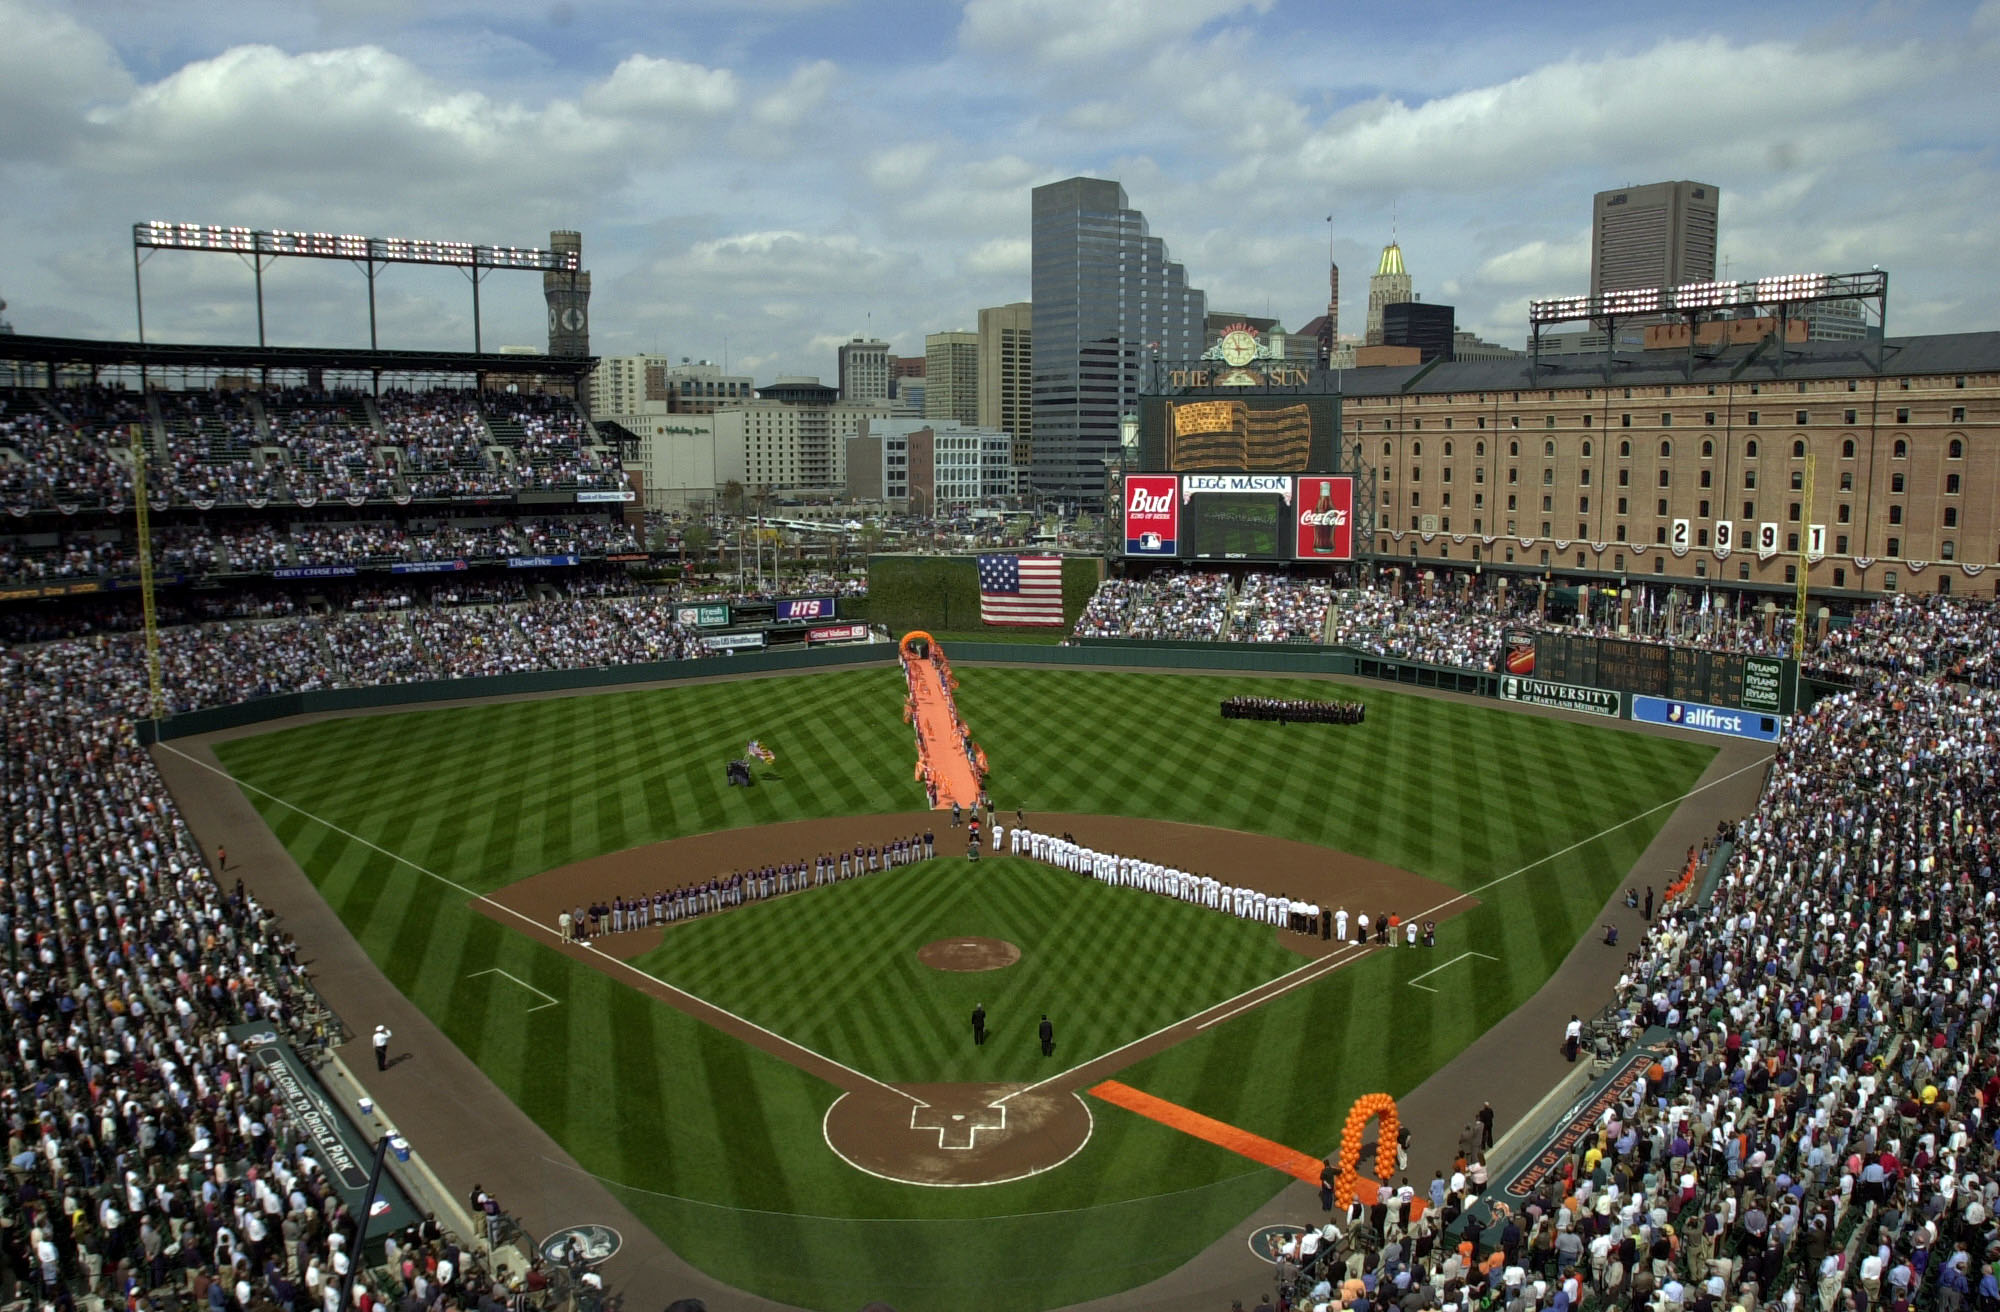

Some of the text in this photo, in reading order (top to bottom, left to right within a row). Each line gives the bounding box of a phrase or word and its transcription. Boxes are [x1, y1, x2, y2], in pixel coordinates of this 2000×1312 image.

[1169, 369, 1310, 387] THE SUN
[1188, 478, 1287, 490] LEGG MASON
[1128, 487, 1174, 512] Bud
[1674, 523, 1820, 550] 2 9 9 1
[273, 566, 356, 577] CHEVY CHASE BANK
[700, 607, 722, 616] Fresh
[789, 600, 820, 616] HTS
[1747, 662, 1779, 674] RYLAND
[1746, 675, 1778, 687] RYLAND
[1522, 680, 1611, 705] UNIVERSITY
[1745, 688, 1777, 700] RYLAND
[1686, 708, 1742, 731] allfirst
